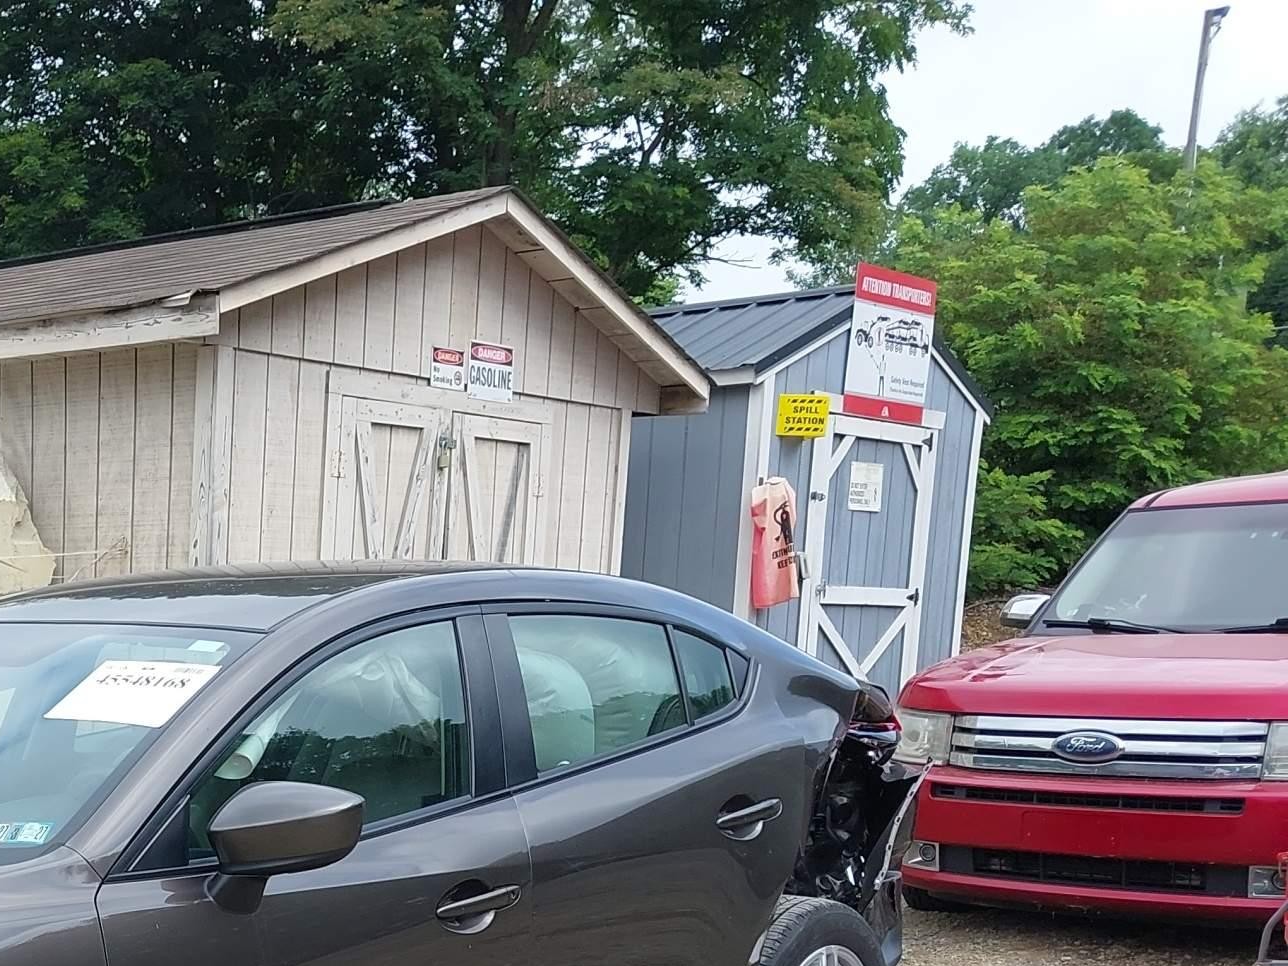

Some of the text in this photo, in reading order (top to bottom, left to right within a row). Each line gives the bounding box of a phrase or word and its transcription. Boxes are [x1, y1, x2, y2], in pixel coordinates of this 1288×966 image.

[861, 276, 932, 307] ATTENTION TRANSPORTERS!
[478, 348, 506, 362] DANGER
[432, 375, 453, 386] Smoking
[469, 364, 512, 390] GASOLINE
[793, 405, 820, 414] SPILL
[785, 416, 825, 425] STATION
[96, 673, 192, 689] 45548168
[1065, 736, 1106, 754] Ford
